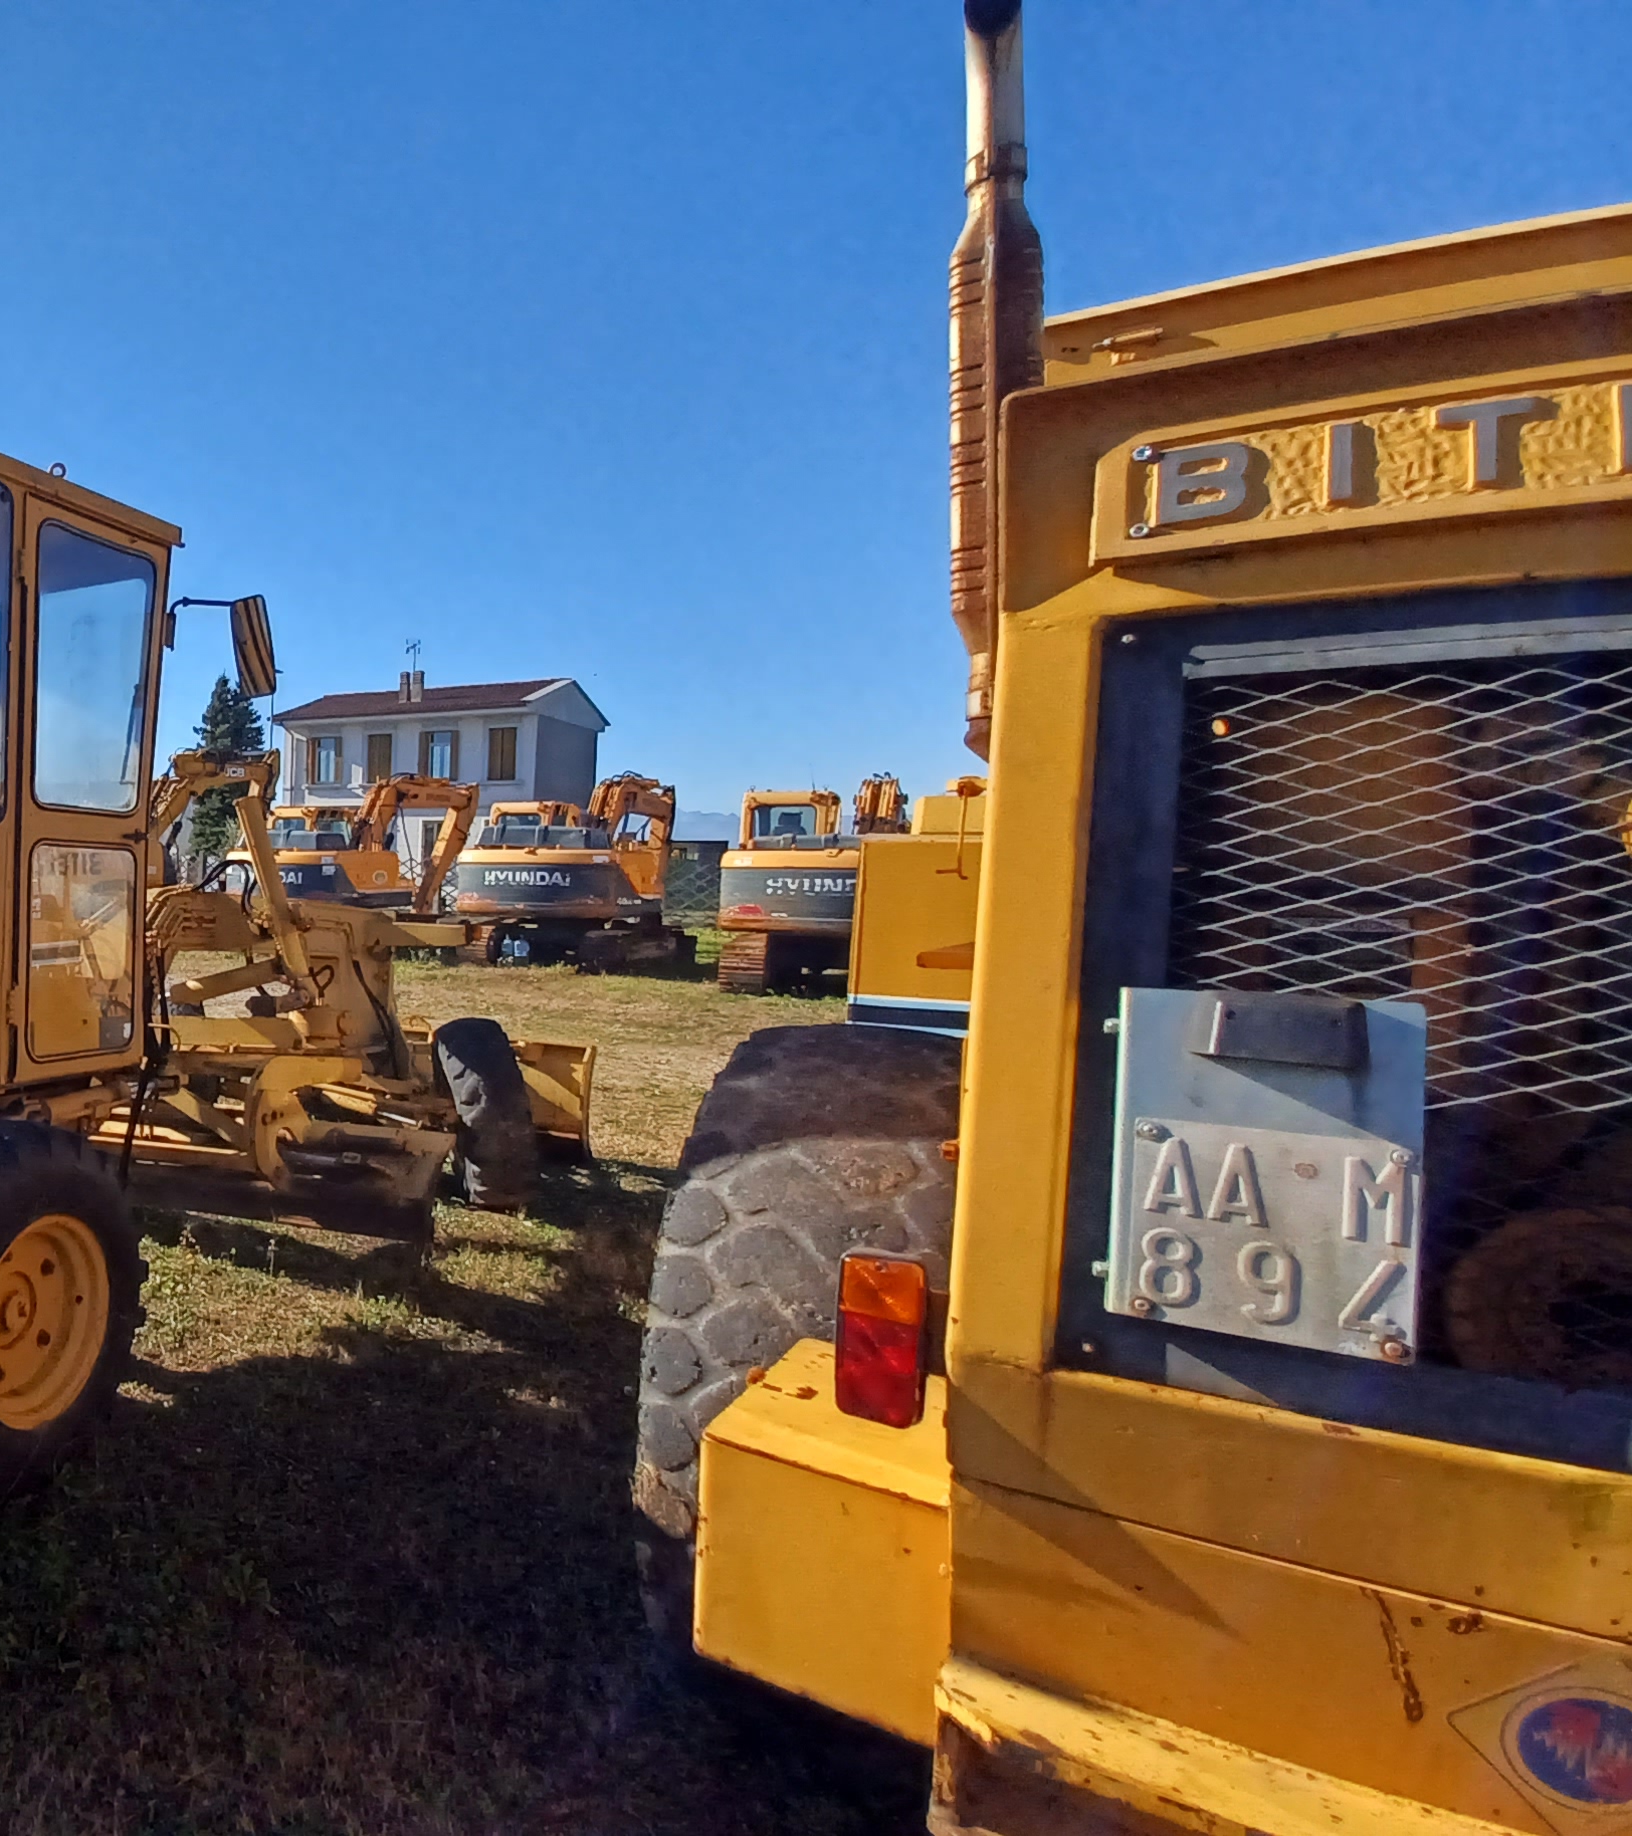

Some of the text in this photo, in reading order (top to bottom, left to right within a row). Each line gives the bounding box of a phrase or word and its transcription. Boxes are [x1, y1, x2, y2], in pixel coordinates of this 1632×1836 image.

[1150, 384, 1632, 527] BIT
[225, 767, 245, 777] JCB
[483, 870, 572, 887] HYUNDAI
[1144, 1137, 1410, 1246] AA M
